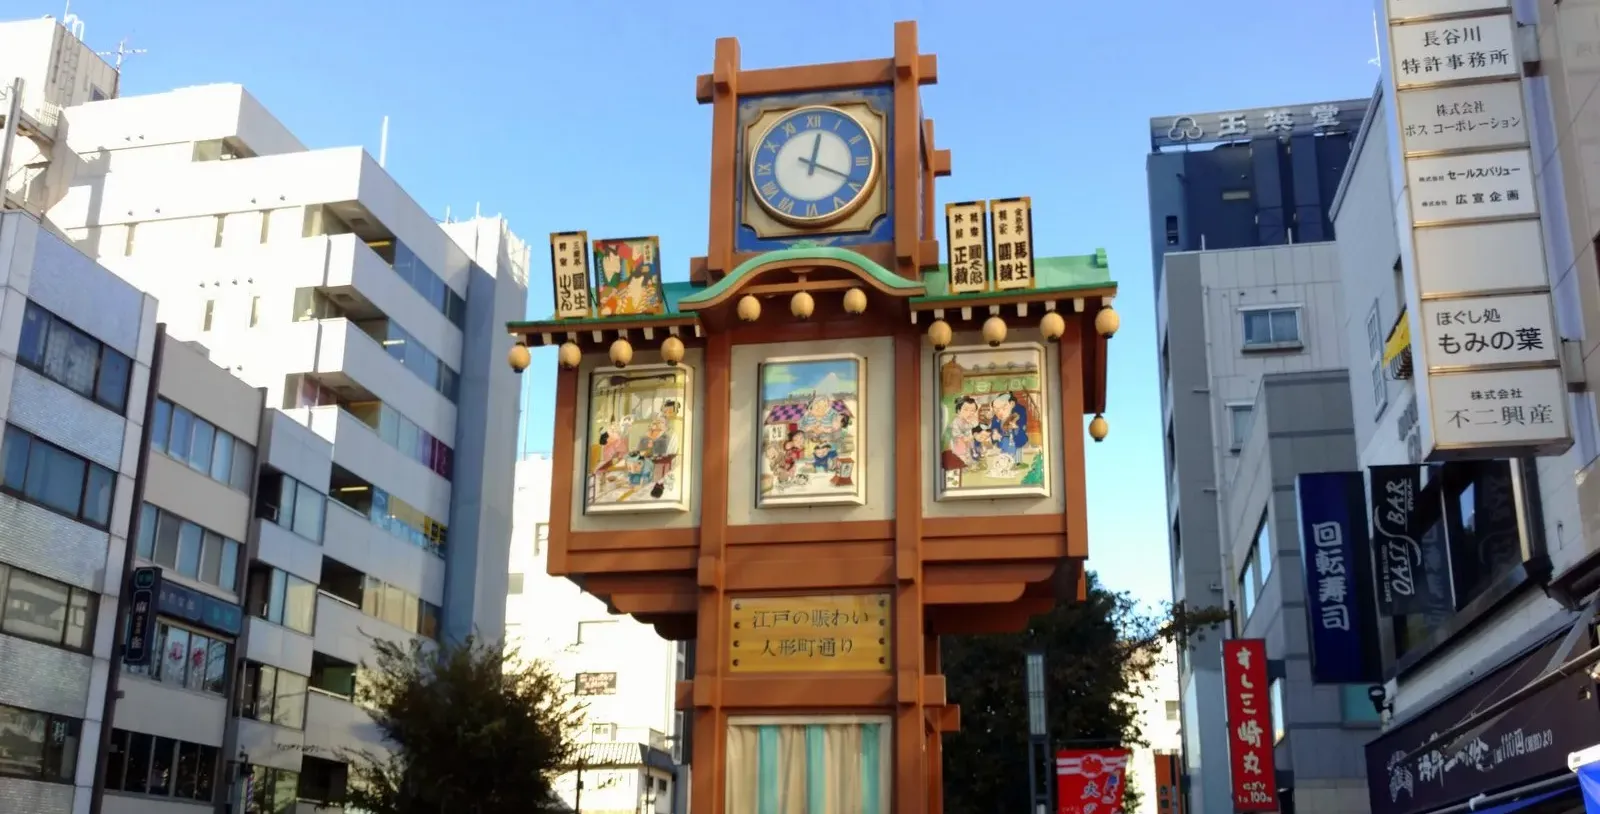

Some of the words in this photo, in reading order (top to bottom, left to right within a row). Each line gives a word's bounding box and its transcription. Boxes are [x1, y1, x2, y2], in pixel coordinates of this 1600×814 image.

[1423, 26, 1481, 47] 長谷川
[1401, 49, 1509, 75] 特許事務所
[1436, 100, 1485, 117] 株式会社
[1447, 166, 1521, 181] セールスバリュー
[1455, 189, 1519, 205] 広宣企画
[1436, 308, 1502, 326] ほぐし処
[1438, 327, 1544, 354] もみの葉
[1470, 388, 1523, 401] 株式会社
[1446, 403, 1554, 429] 不二興産
[1386, 478, 1406, 525] BAR
[1312, 520, 1350, 631] 回転寿司
[752, 608, 869, 629] 江戸の賑わい
[760, 637, 853, 658] 人形町通り
[1236, 646, 1264, 775] すし三崎丸
